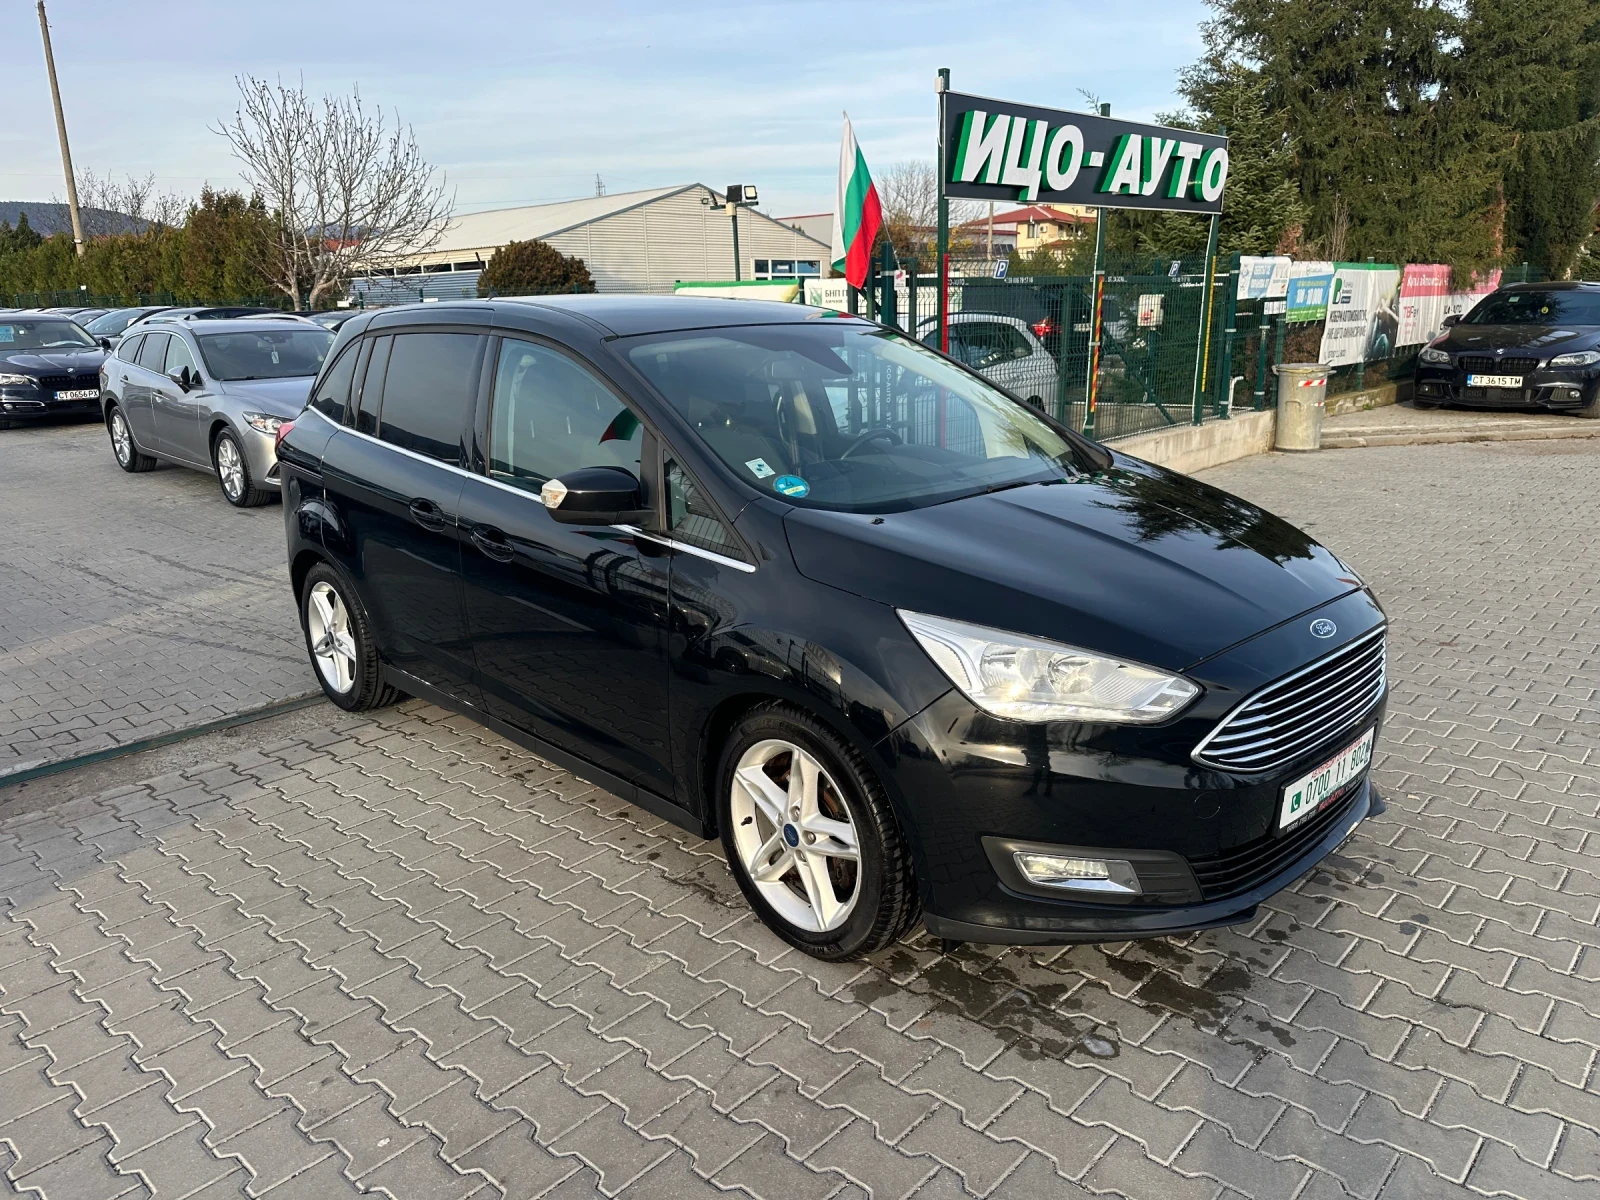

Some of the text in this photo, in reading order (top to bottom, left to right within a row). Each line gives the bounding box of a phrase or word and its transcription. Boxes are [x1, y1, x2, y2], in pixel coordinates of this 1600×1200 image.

[957, 110, 1229, 202] ИЦО-АУТО
[997, 262, 1007, 277] P
[1472, 376, 1521, 385] CT 3615 TM
[58, 391, 68, 399] CT
[70, 390, 88, 398] 0656
[784, 478, 794, 487] 4
[1314, 621, 1333, 635] Ford
[1305, 769, 1331, 805] 0700
